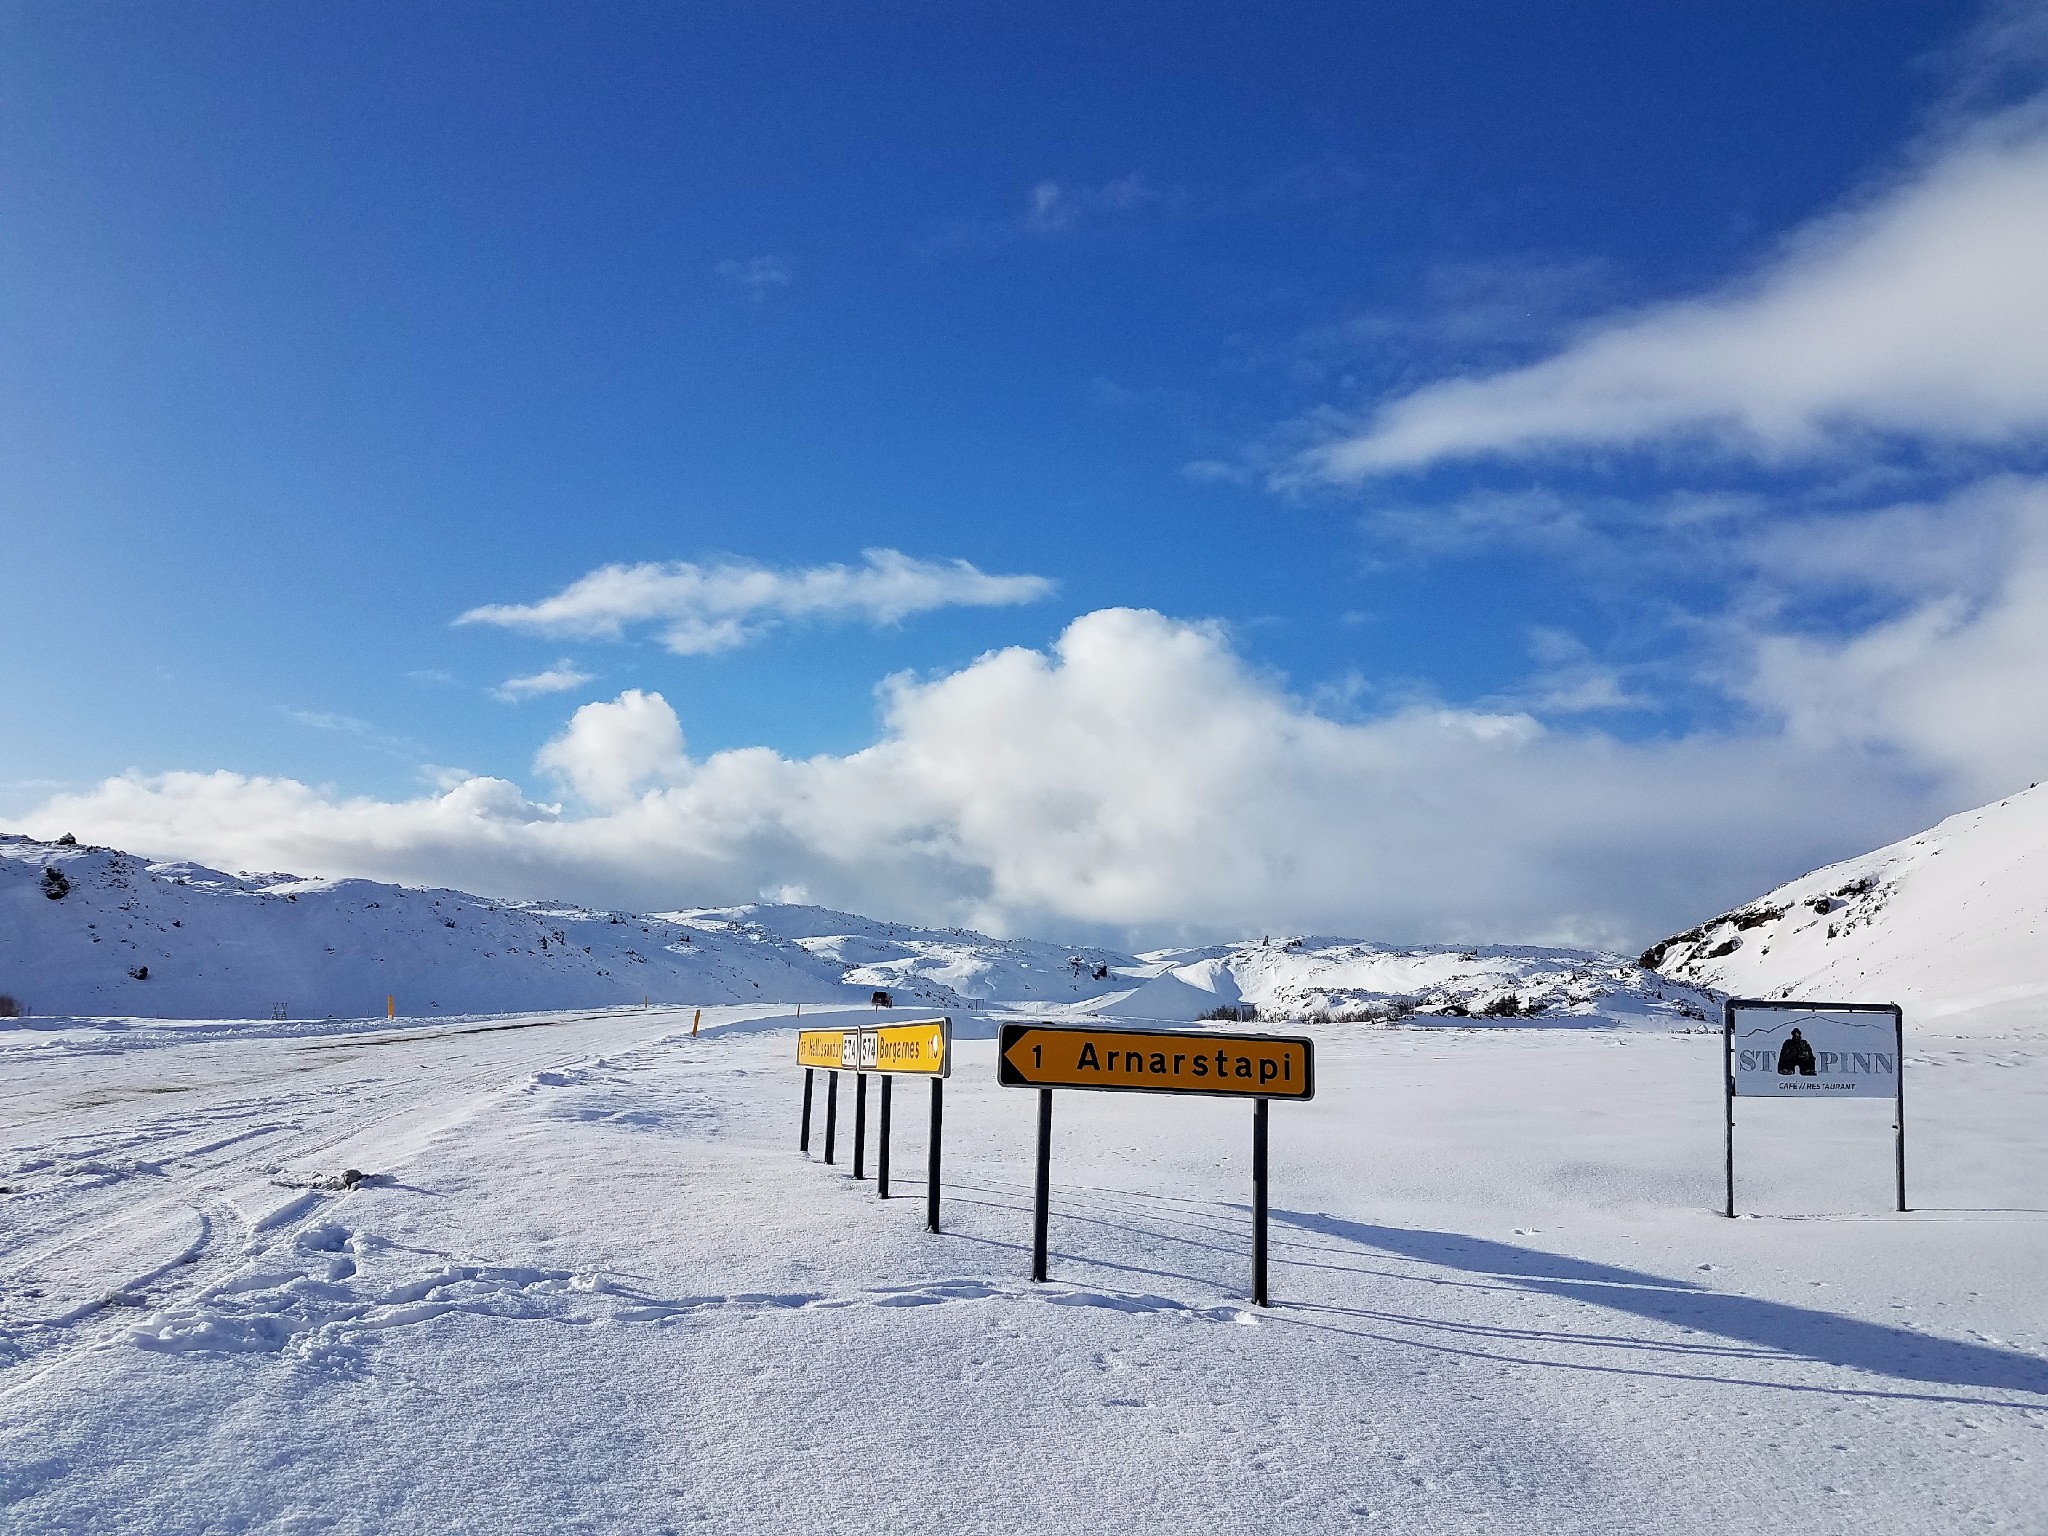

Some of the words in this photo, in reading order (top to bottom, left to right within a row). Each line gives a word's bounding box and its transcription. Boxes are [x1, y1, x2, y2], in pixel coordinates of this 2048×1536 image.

[844, 1039, 856, 1060] 574
[862, 1038, 876, 1061] 574
[879, 1037, 919, 1064] Borgarnes
[1031, 1044, 1042, 1069] 1
[1076, 1041, 1292, 1085] Arnarstapi
